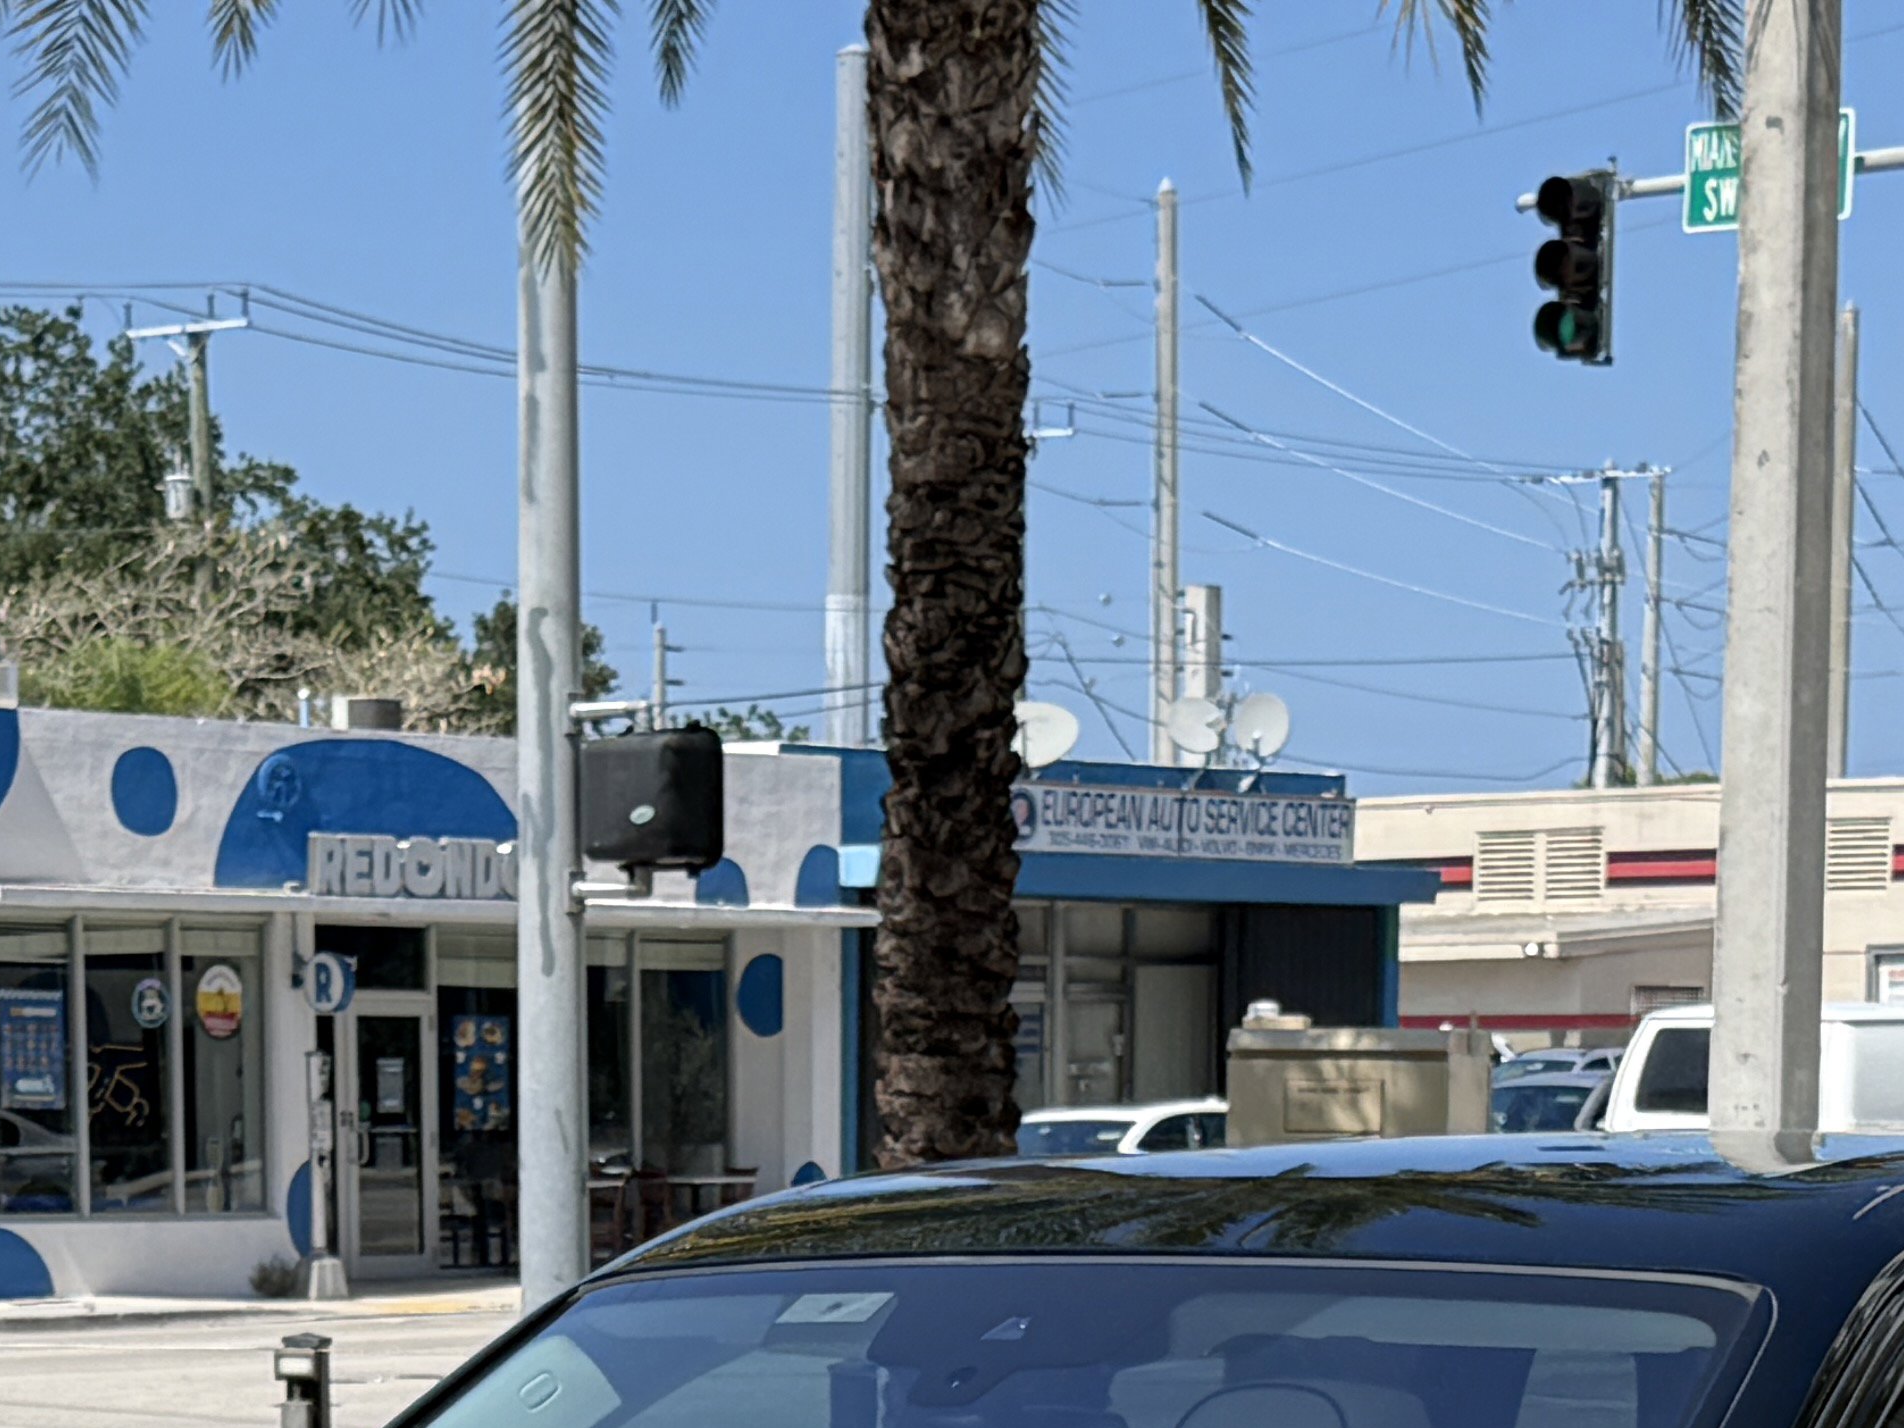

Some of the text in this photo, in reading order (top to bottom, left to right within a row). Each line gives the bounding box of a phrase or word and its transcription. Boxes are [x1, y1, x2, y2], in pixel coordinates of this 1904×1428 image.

[1703, 176, 1739, 222] SW
[1043, 789, 1351, 839] EUROPEAN AUTO SERVICE CENTER
[315, 962, 332, 1003] R
